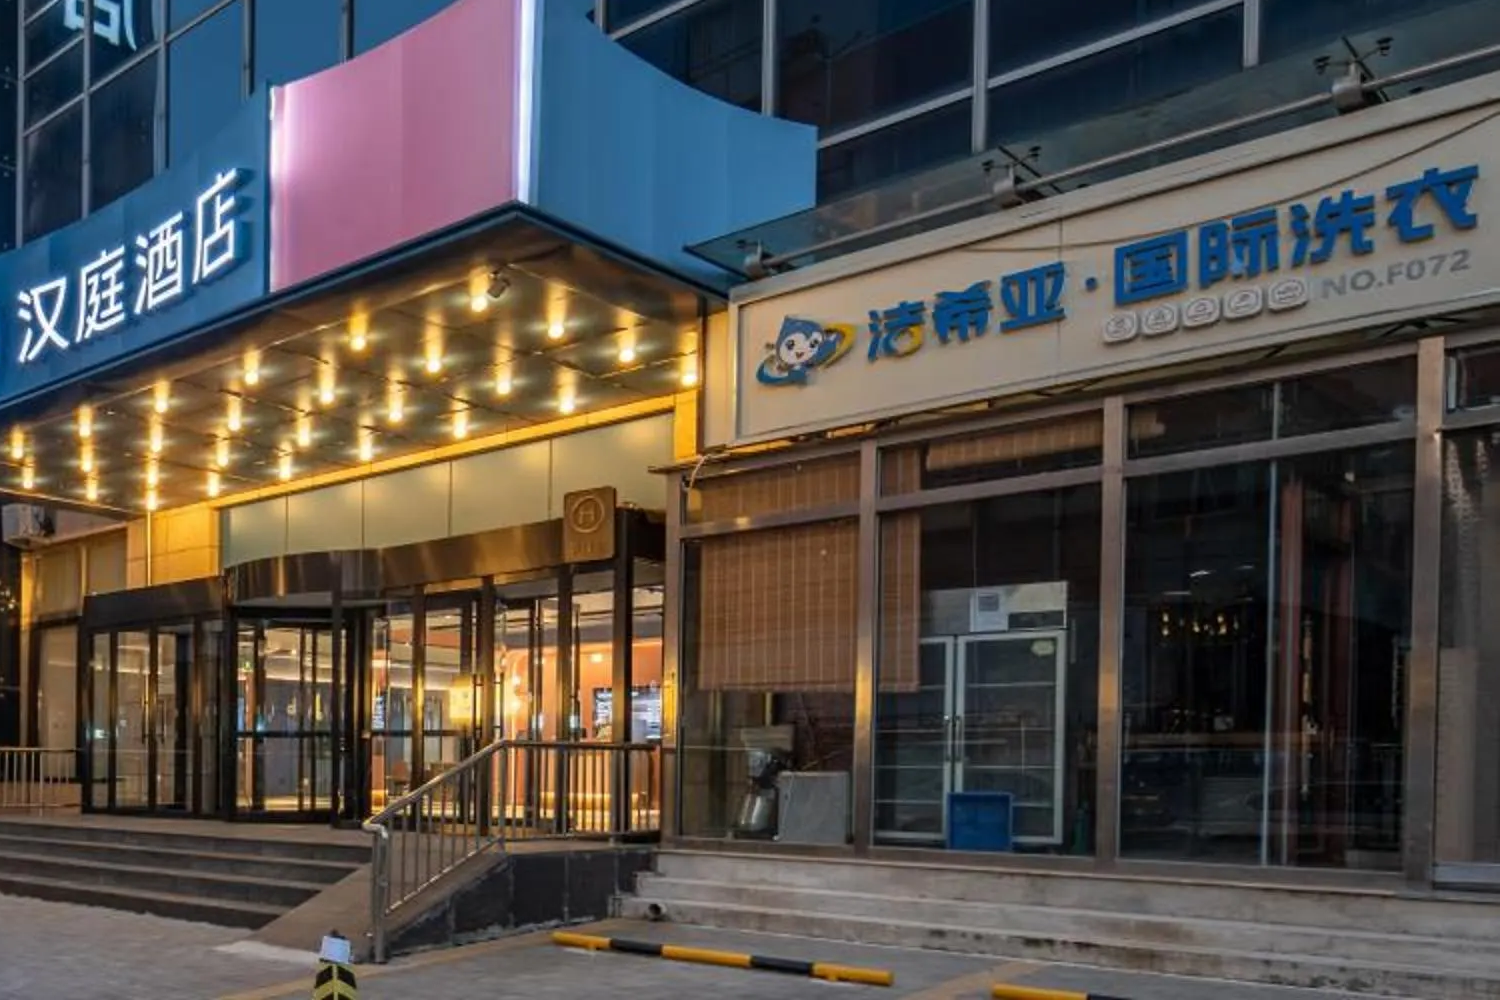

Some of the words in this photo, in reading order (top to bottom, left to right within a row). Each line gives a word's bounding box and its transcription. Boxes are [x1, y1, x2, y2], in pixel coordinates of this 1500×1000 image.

[17, 168, 238, 363] 汉庭酒店
[1322, 249, 1470, 299] NO.F072
